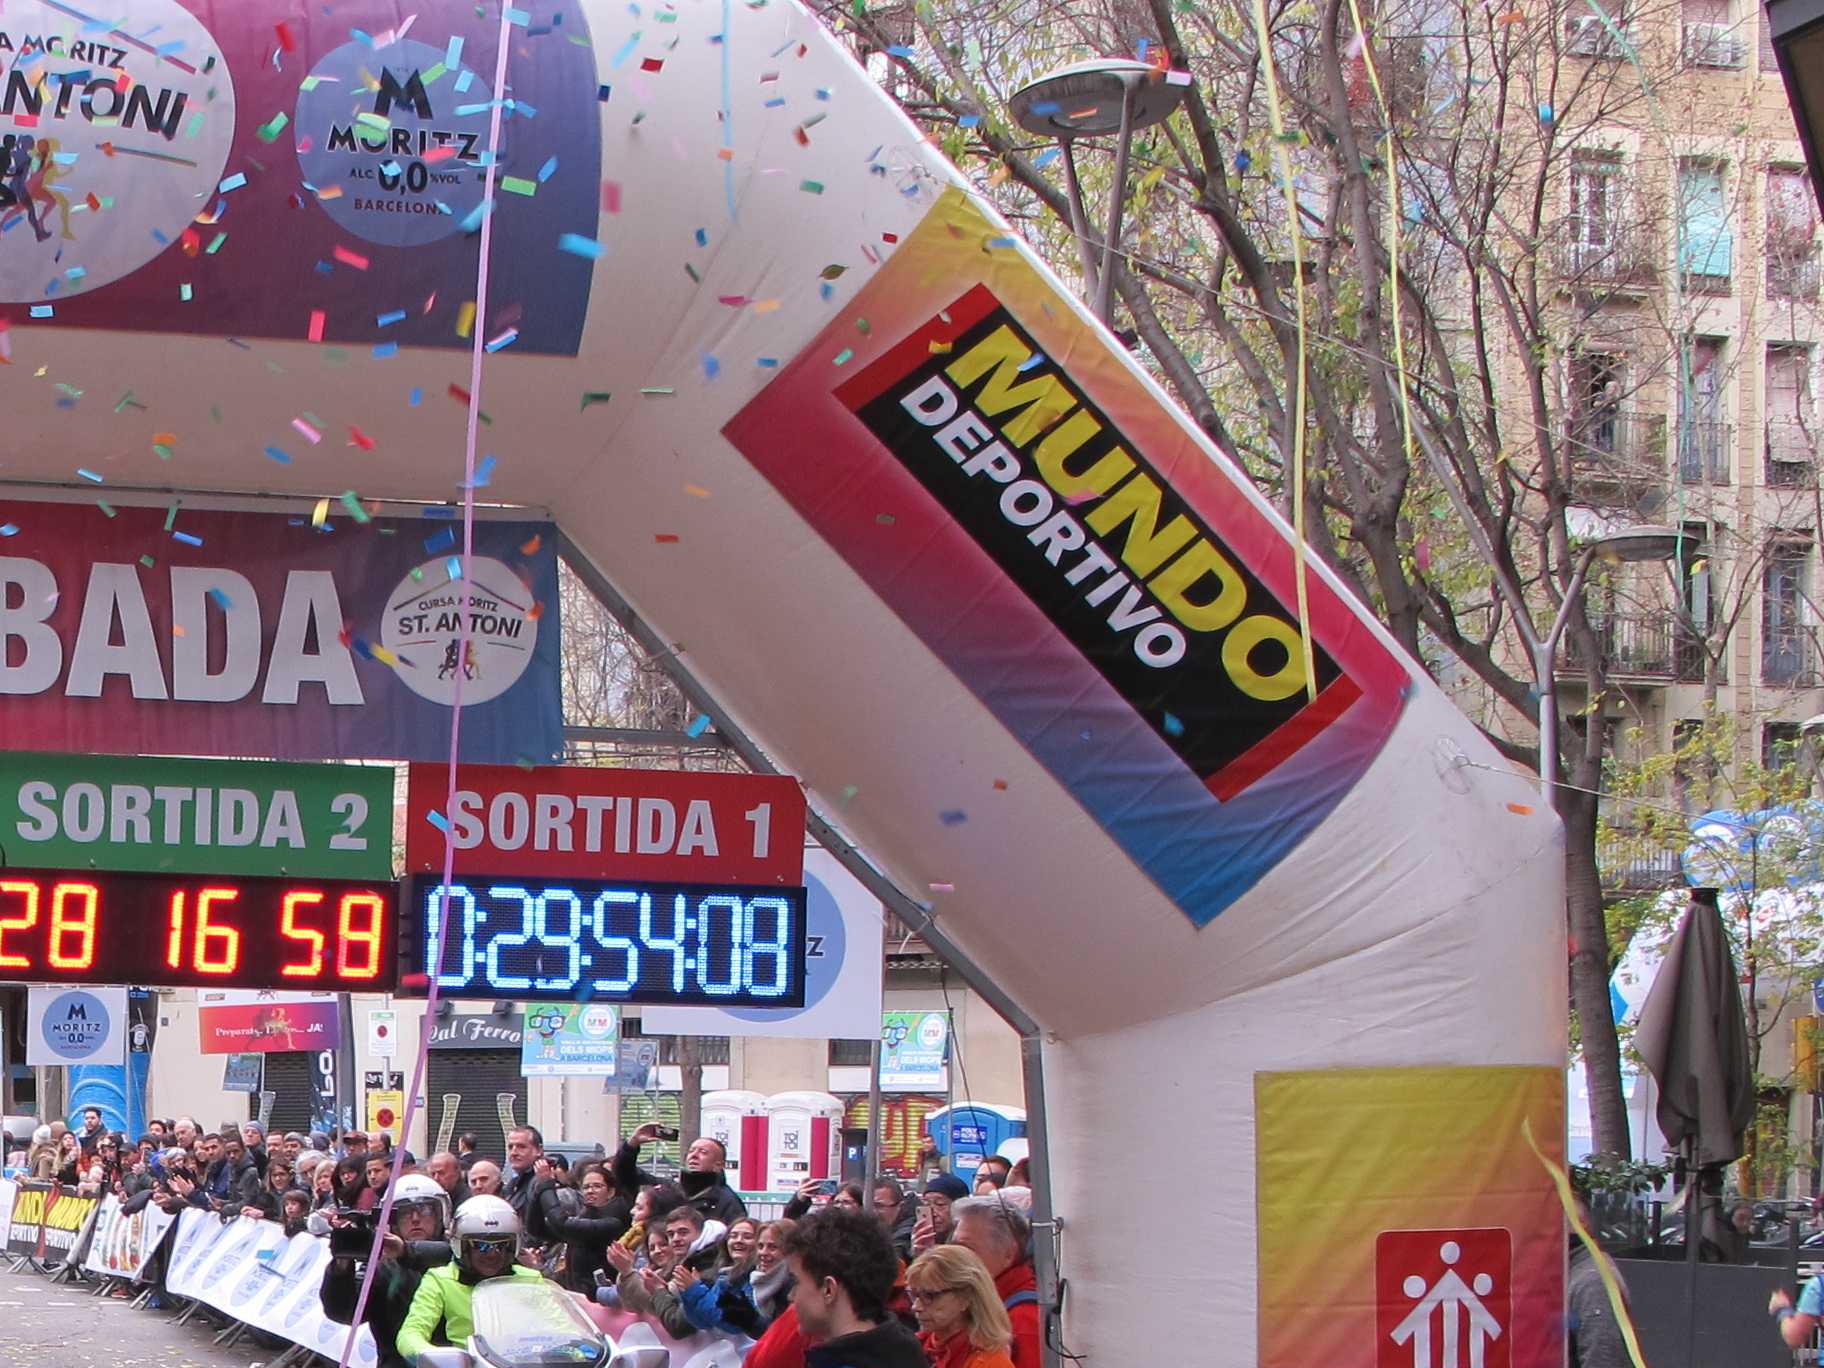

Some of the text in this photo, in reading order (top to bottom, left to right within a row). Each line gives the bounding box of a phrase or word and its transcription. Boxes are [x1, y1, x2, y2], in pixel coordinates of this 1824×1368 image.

[327, 122, 481, 161] MORITZ
[899, 375, 1188, 669] DEPORTIVO
[944, 323, 1313, 702] MUNDO
[398, 614, 430, 636] ST.
[418, 596, 456, 611] CURSA
[16, 782, 369, 851] SORTIDA 2
[449, 791, 770, 860] SORTIDA 1
[168, 888, 238, 975] 16
[52, 1023, 102, 1032] MORITZ
[462, 1018, 521, 1044] Ferro
